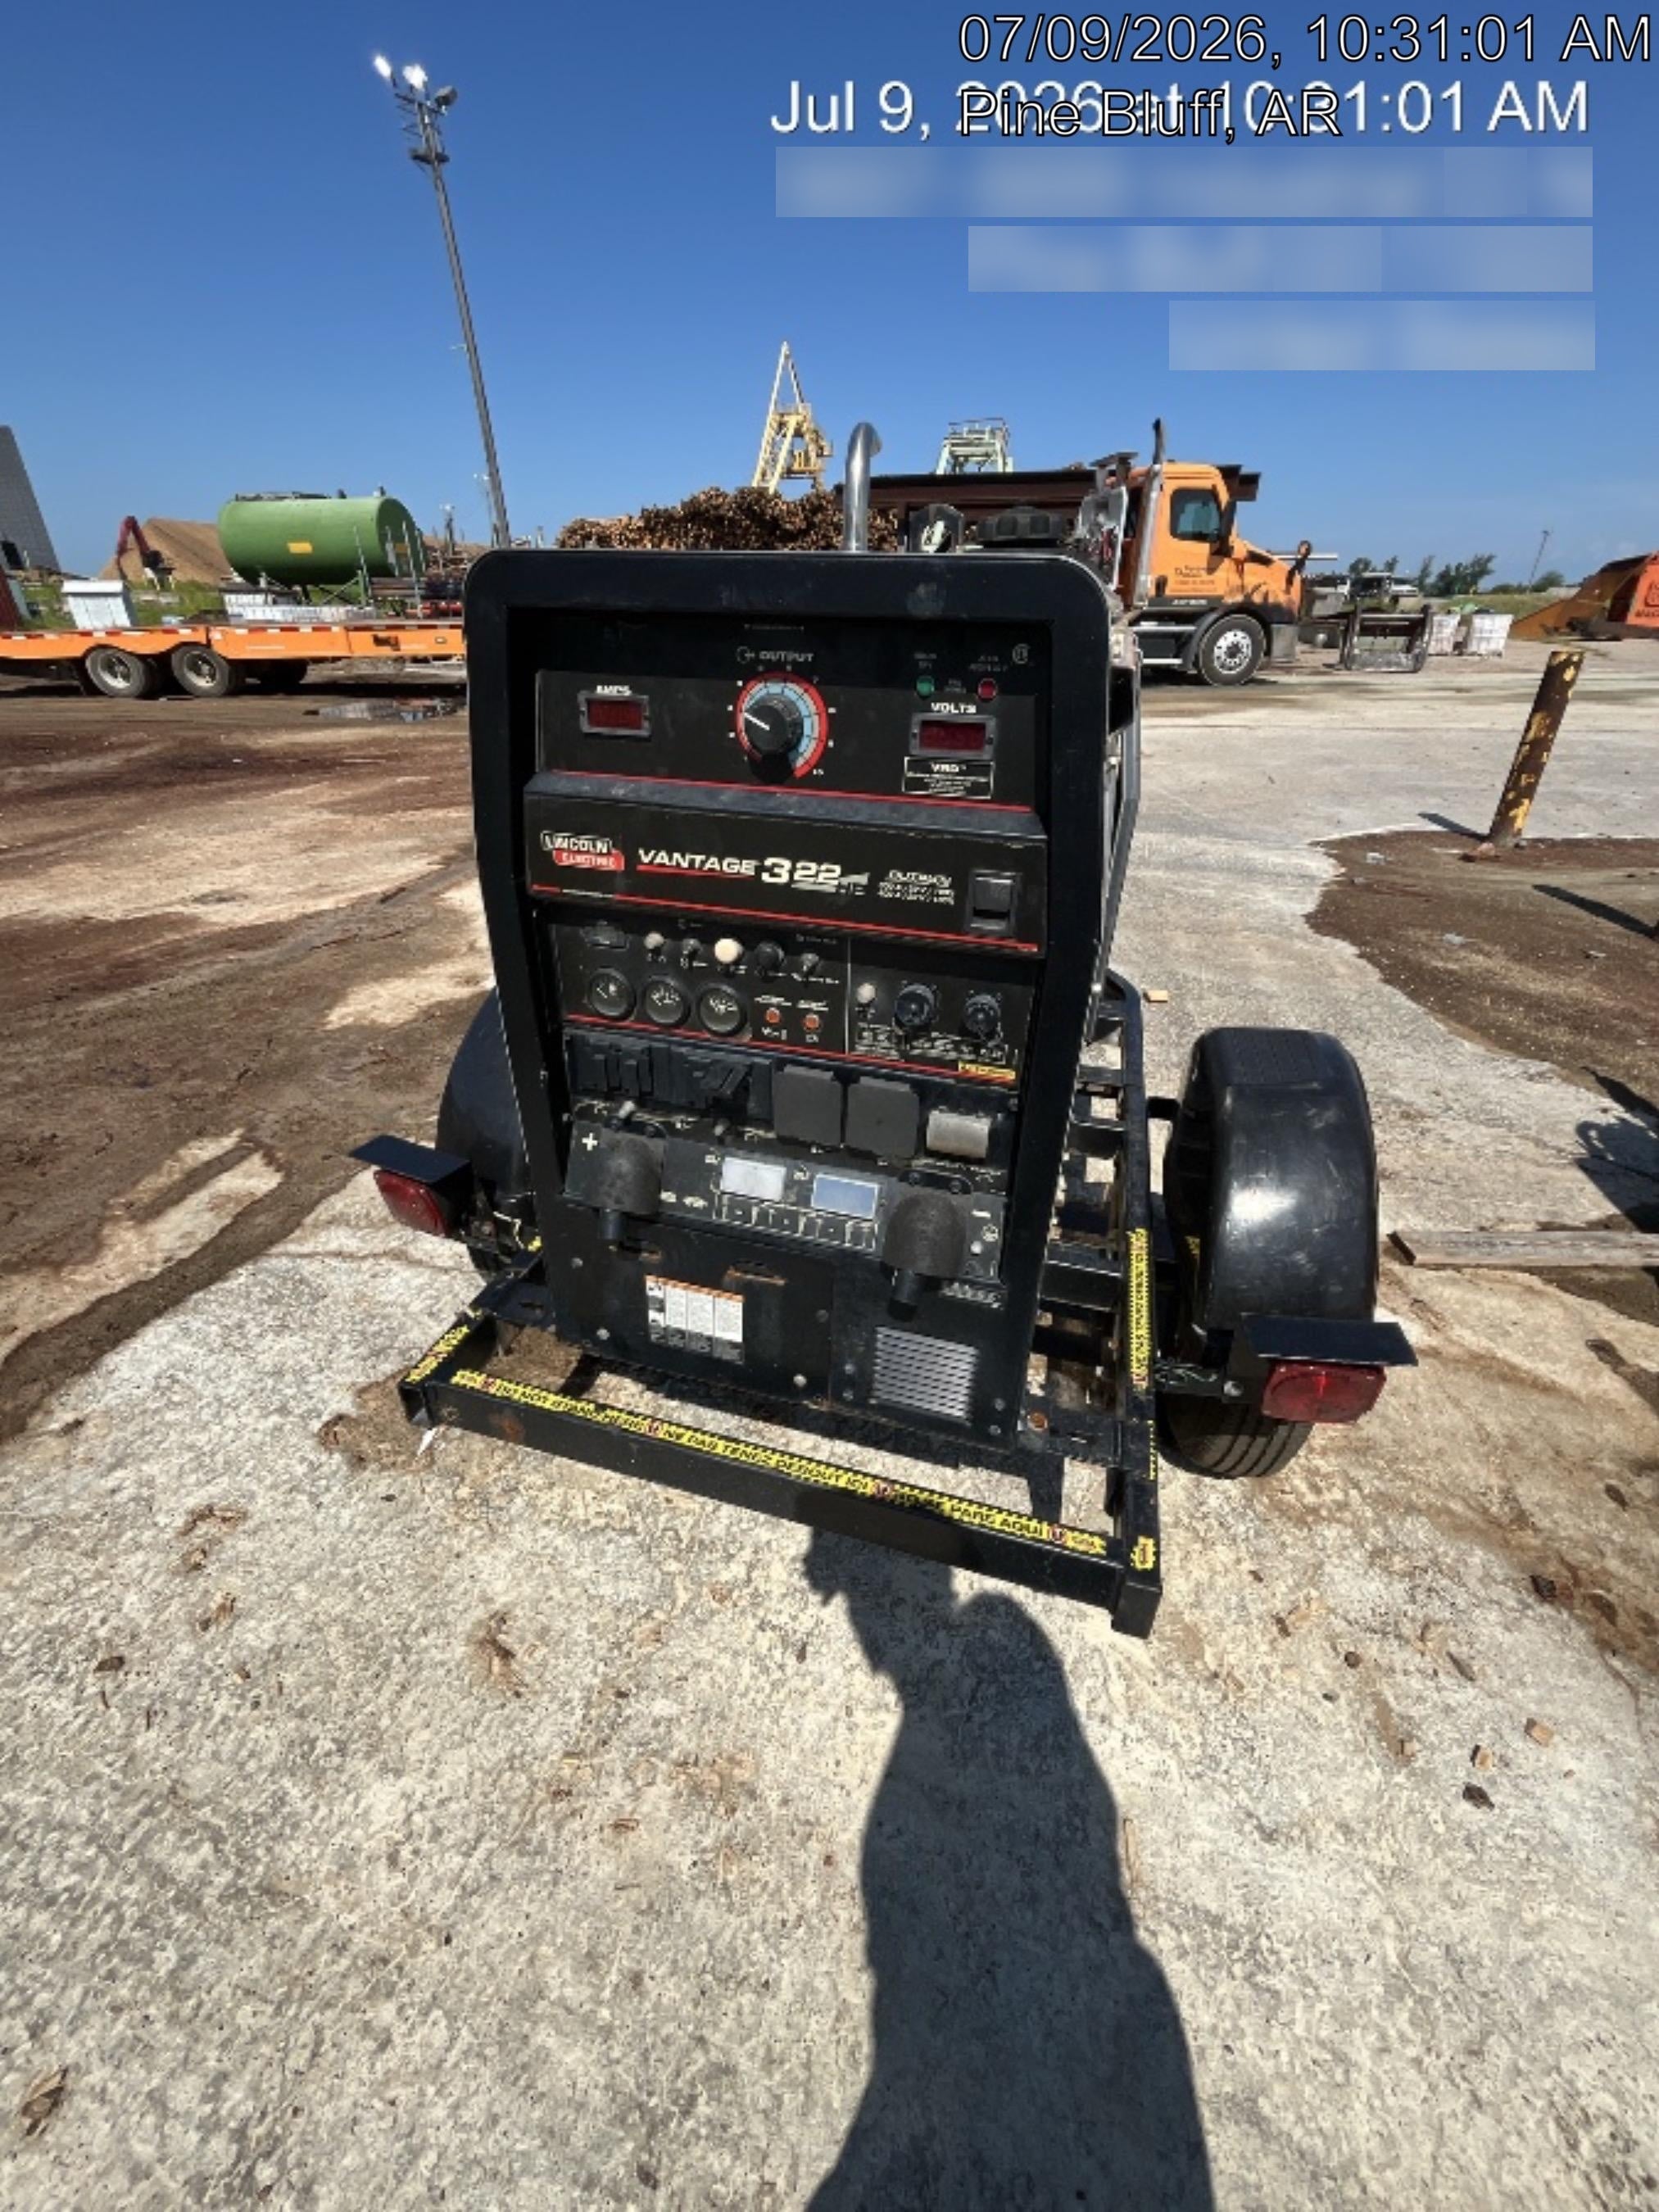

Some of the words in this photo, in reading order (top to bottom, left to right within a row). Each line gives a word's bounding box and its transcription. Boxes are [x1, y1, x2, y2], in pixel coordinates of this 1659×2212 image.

[931, 702, 977, 714] VOLTS
[543, 834, 610, 854] LINCOLN
[638, 848, 756, 876] VANTAGE
[761, 857, 842, 886] 322
